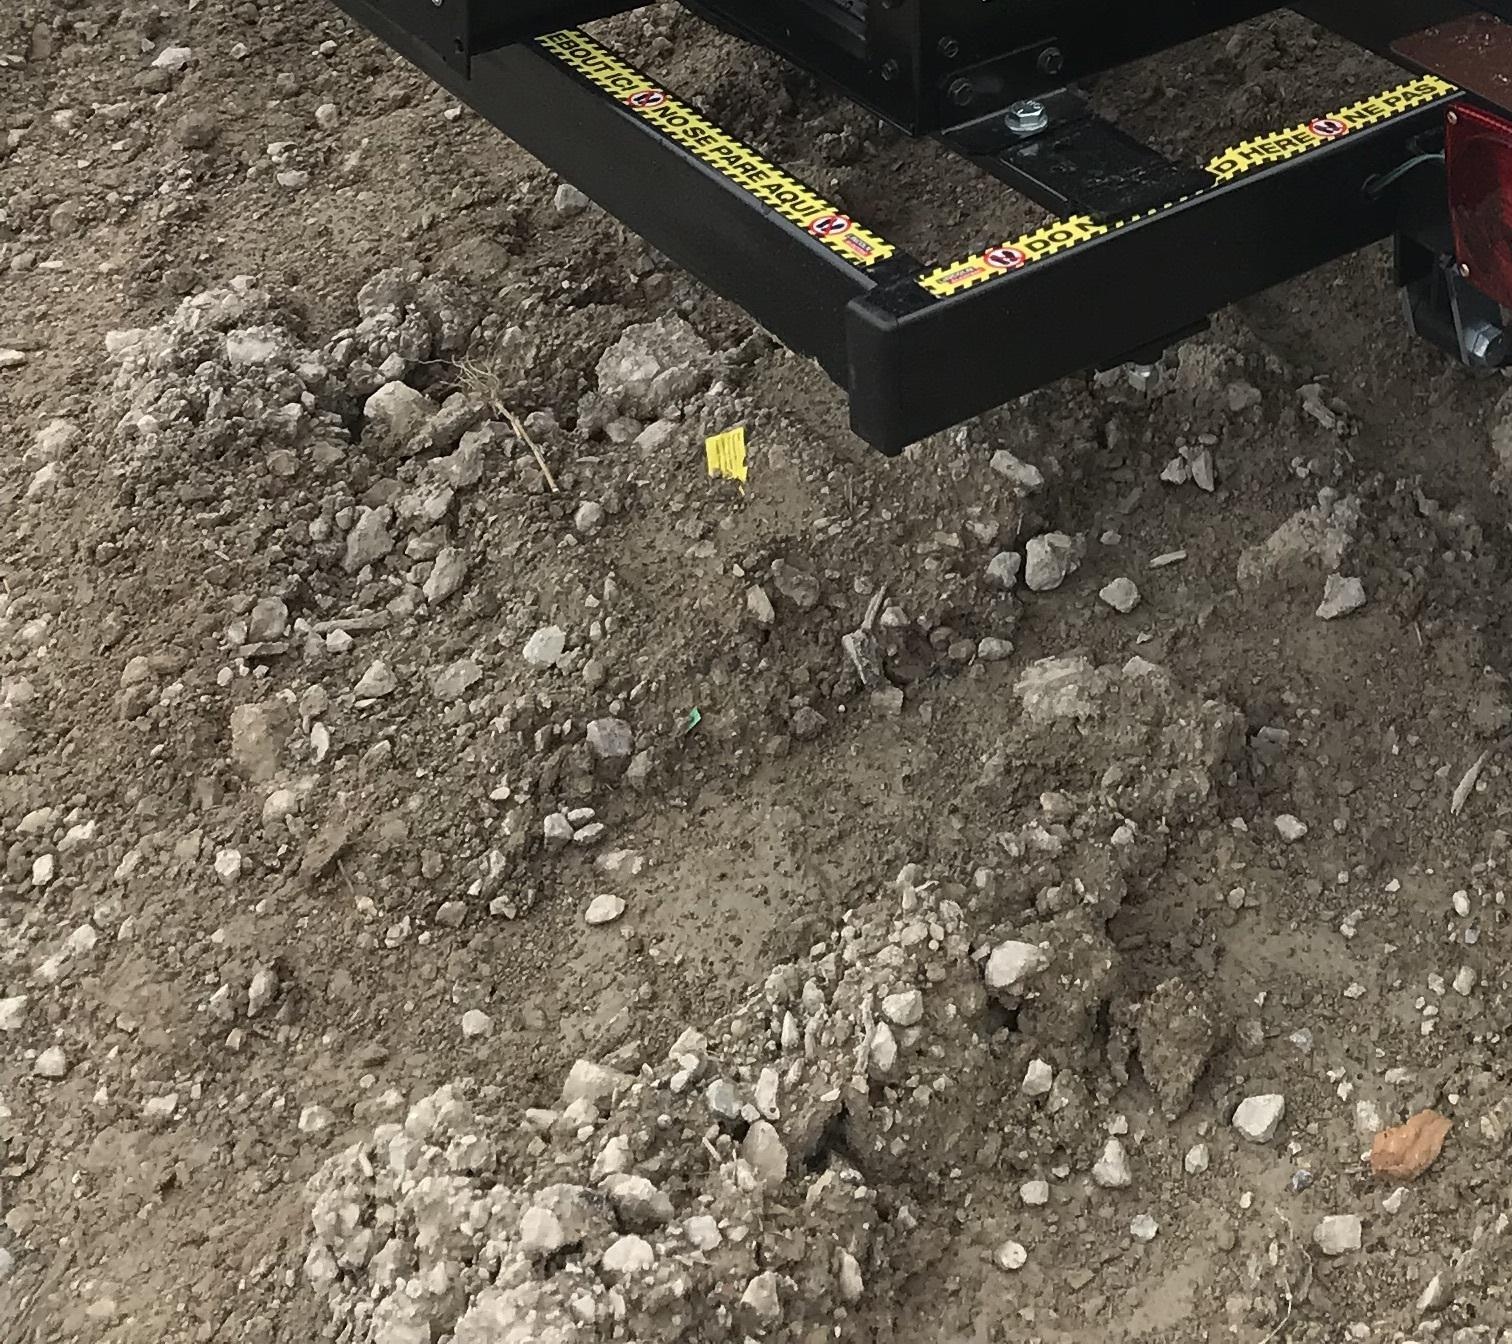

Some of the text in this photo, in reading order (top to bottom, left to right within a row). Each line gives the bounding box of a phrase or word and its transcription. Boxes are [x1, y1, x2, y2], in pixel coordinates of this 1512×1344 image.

[604, 73, 640, 91] ICI
[1342, 82, 1438, 124] NE PAS
[655, 105, 690, 128] NO
[682, 127, 718, 147] SE
[709, 145, 772, 183] PARE
[1239, 131, 1316, 161] HERE
[1025, 229, 1074, 253] DO
